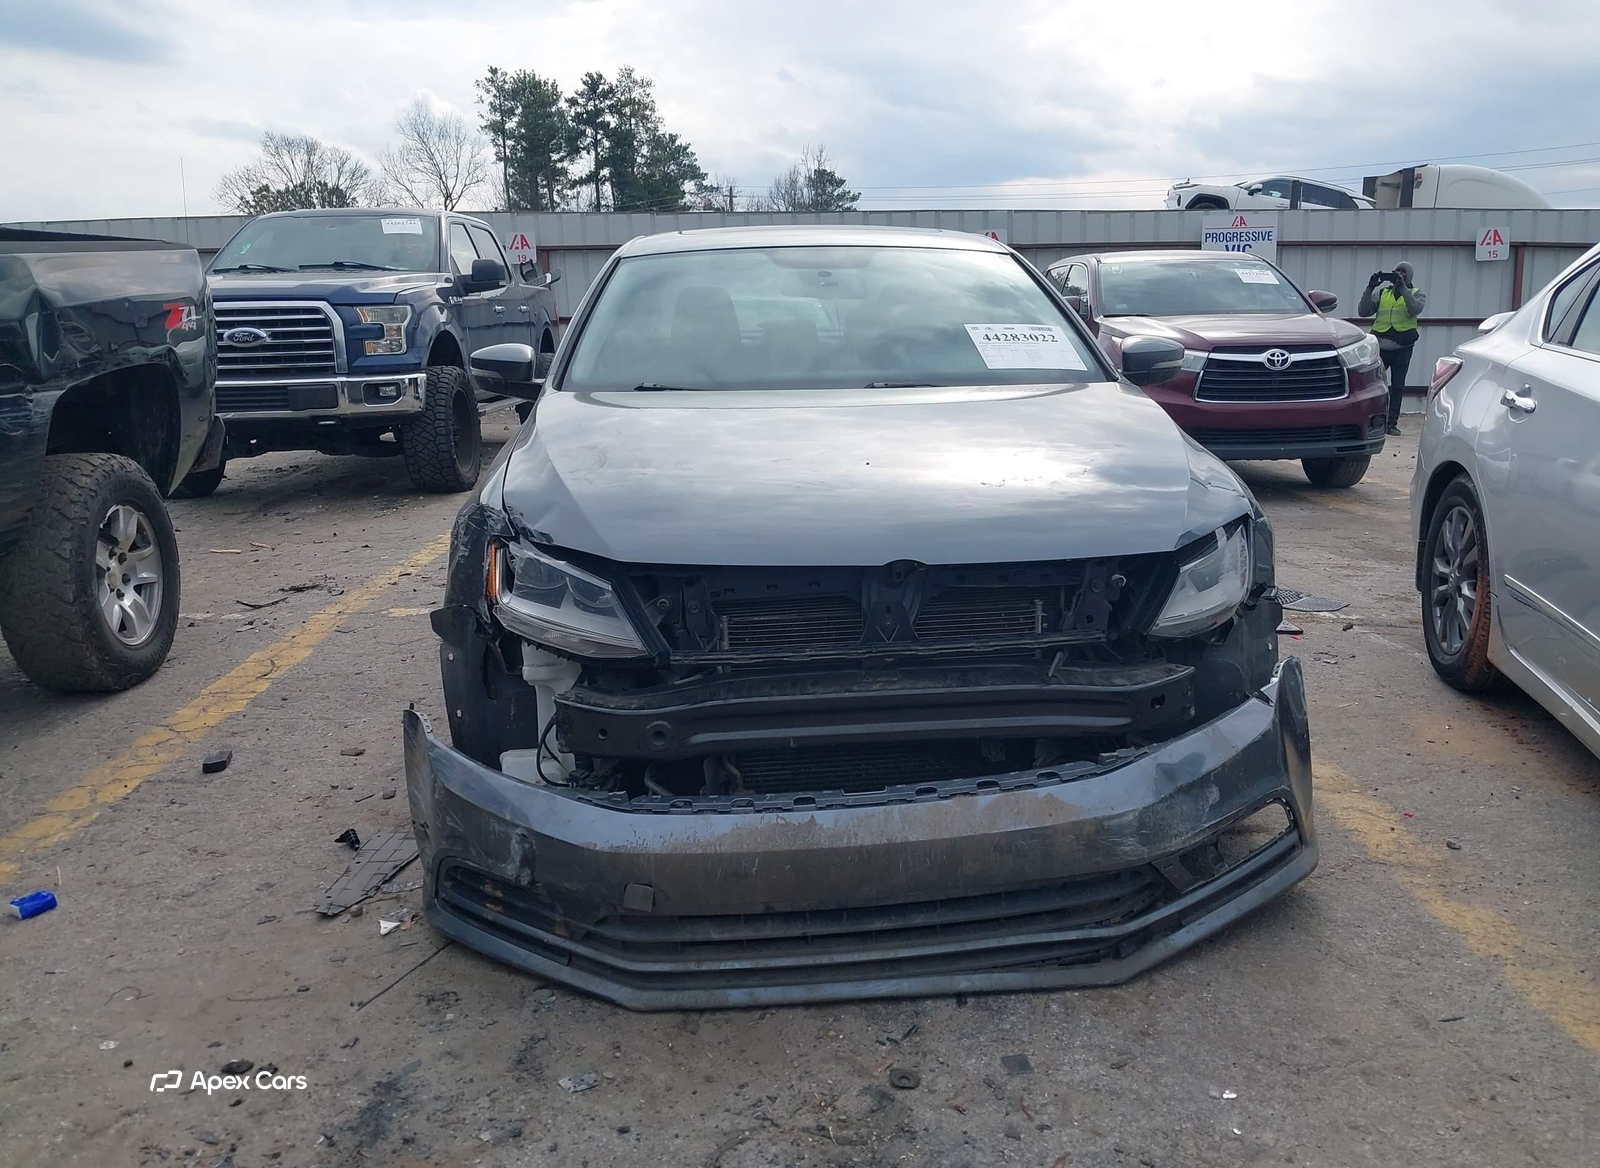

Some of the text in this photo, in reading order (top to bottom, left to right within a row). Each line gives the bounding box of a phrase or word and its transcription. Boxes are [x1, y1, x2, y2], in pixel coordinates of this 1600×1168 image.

[1204, 230, 1273, 243] PROGRESSIVE
[516, 254, 527, 262] 19
[1487, 250, 1498, 259] 15
[232, 332, 255, 342] Ford
[982, 333, 1058, 343] 44283022
